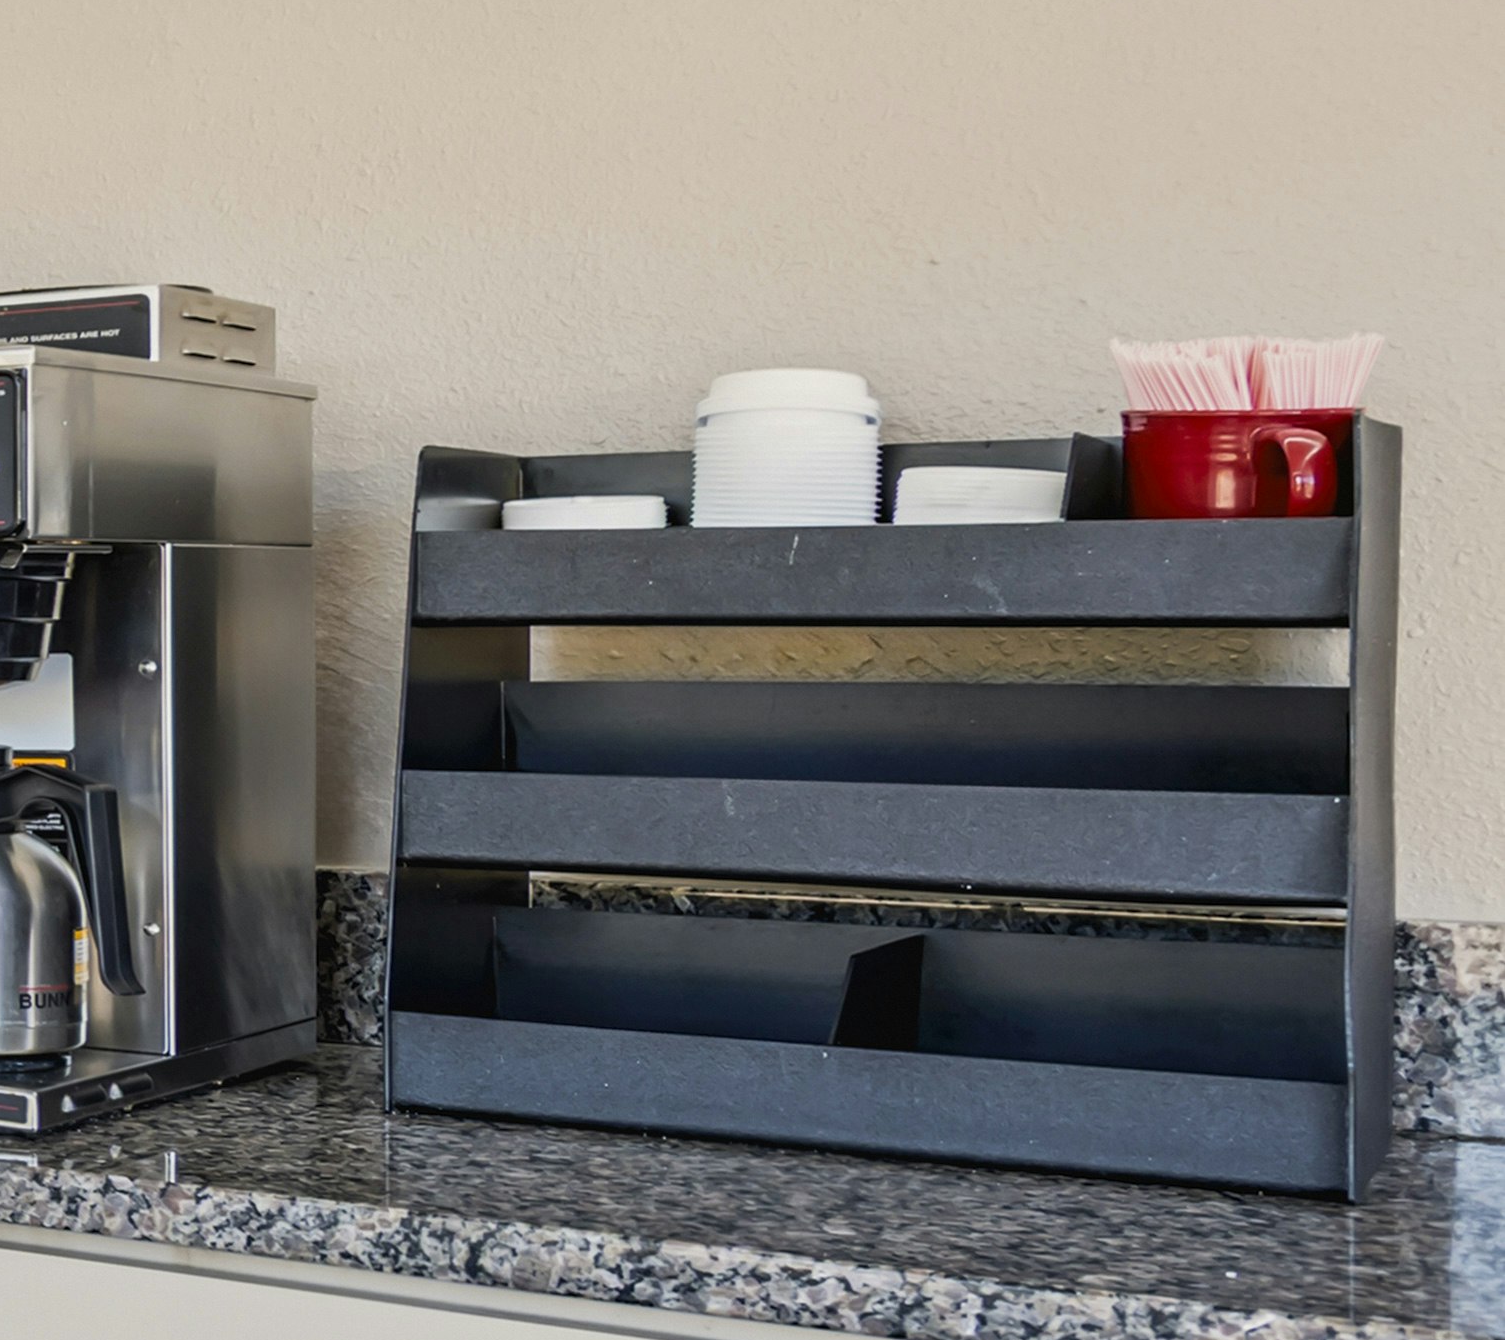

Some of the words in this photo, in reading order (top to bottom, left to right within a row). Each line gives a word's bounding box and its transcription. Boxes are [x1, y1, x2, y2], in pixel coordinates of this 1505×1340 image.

[31, 332, 78, 342] SURFACES
[79, 329, 99, 339] ARE
[100, 328, 120, 337] HOT
[19, 991, 71, 1010] BUNN
